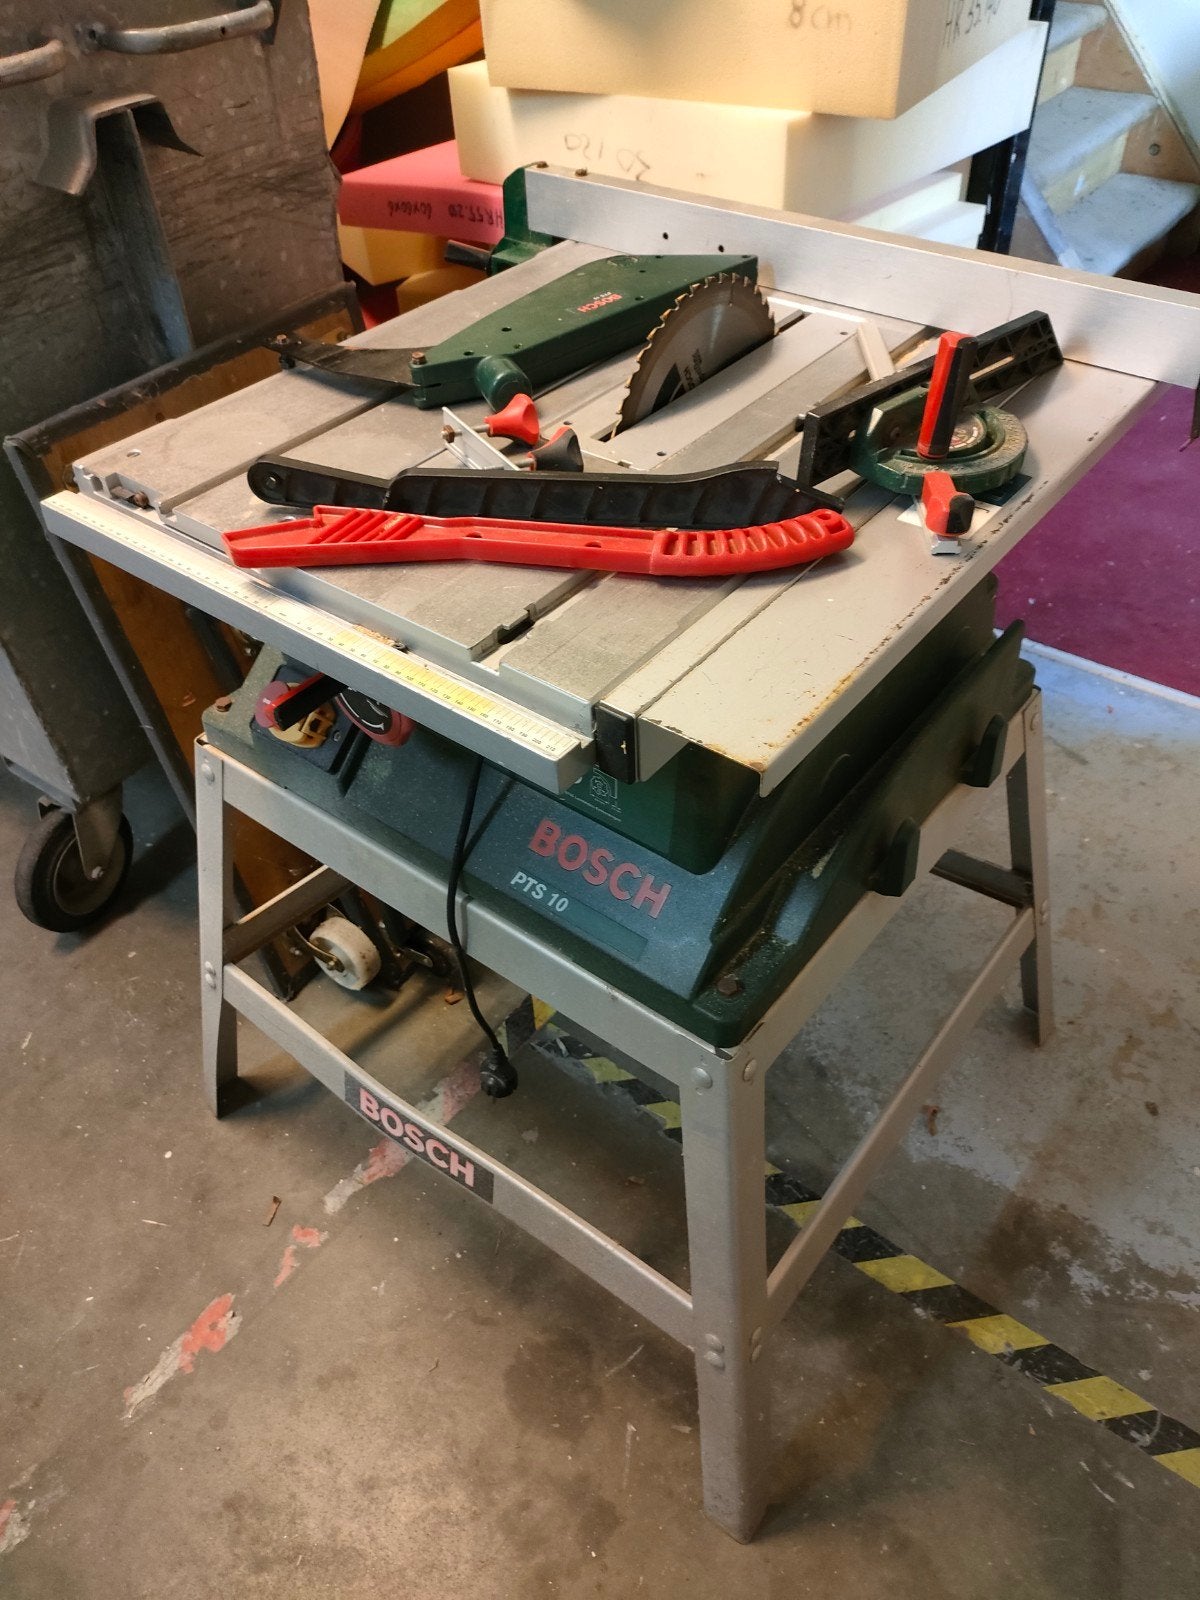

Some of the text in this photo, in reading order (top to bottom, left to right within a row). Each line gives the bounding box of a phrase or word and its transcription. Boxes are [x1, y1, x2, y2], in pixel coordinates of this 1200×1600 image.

[510, 870, 570, 913] PTS 10
[528, 817, 673, 919] BOSCH
[359, 1087, 475, 1188] BOSCH
